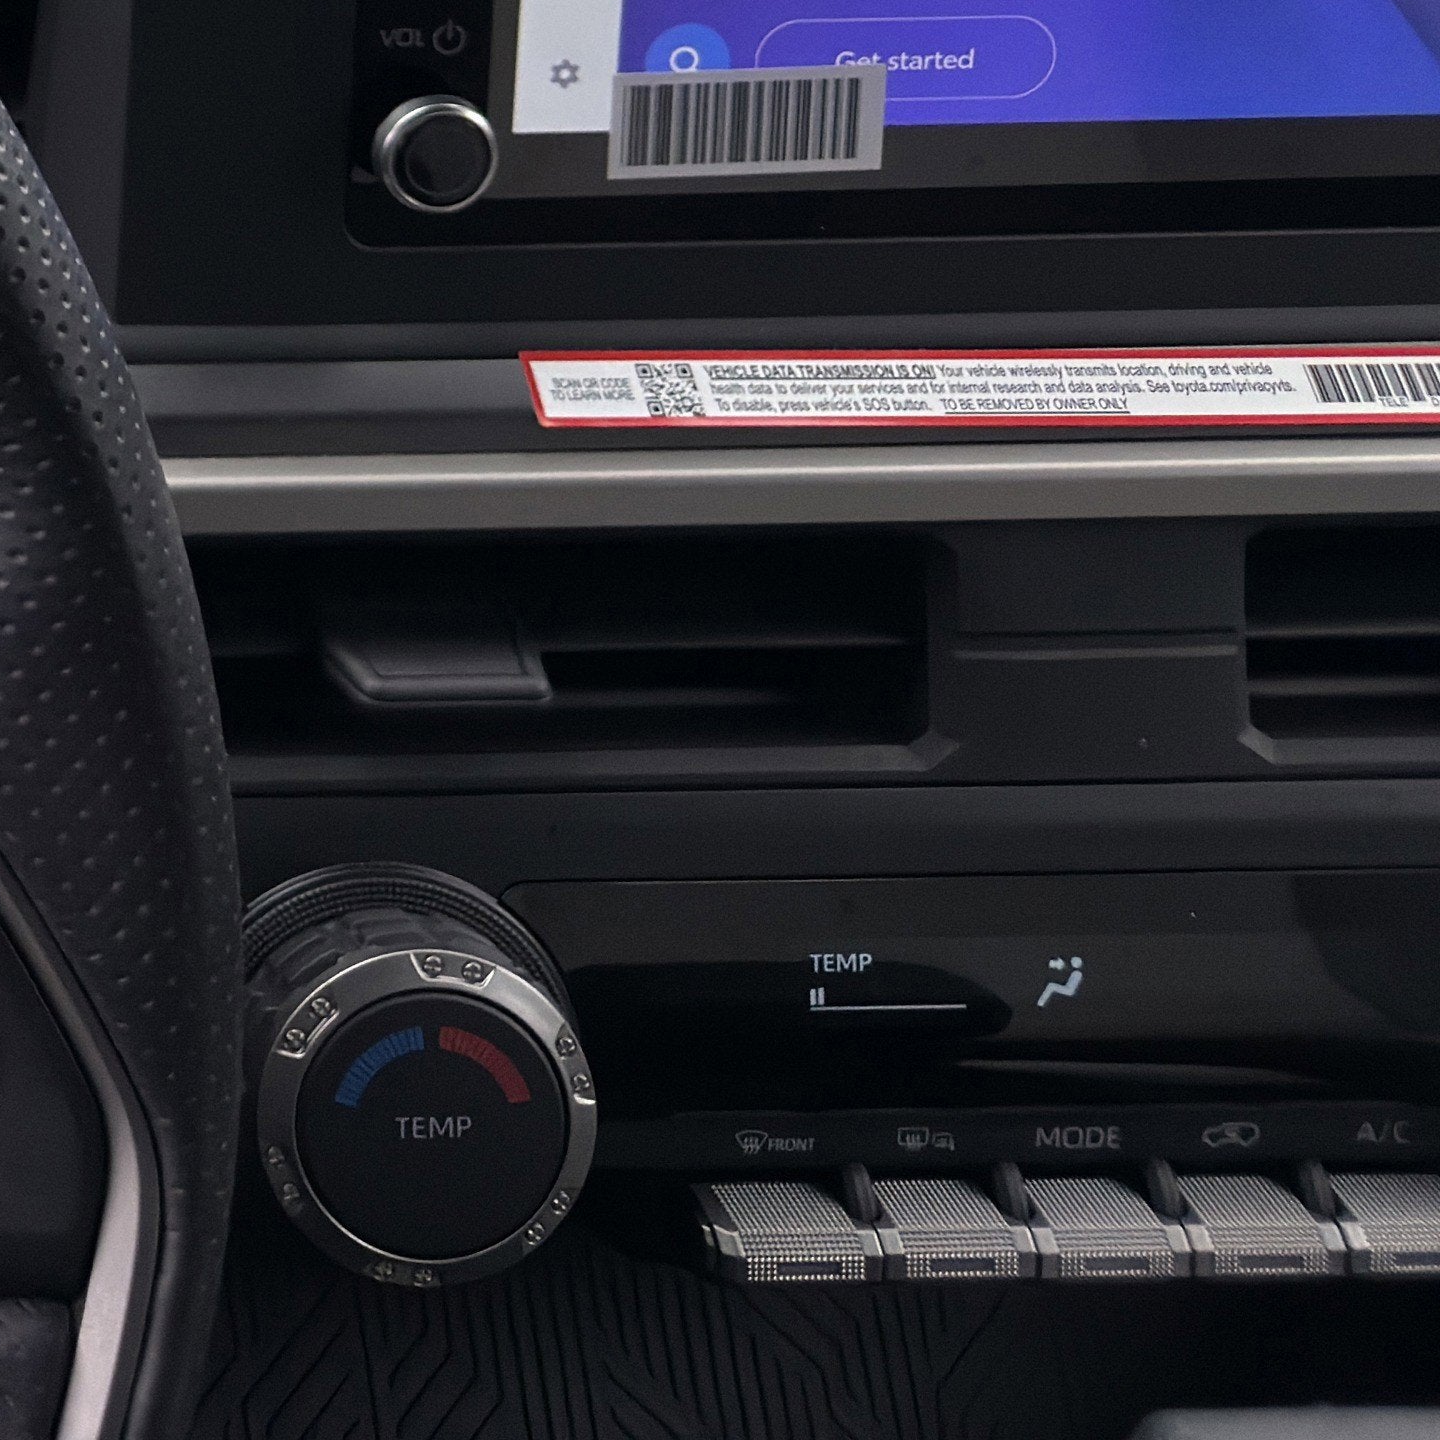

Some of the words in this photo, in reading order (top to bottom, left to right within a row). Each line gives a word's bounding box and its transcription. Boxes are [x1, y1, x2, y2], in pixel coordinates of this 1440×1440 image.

[381, 30, 424, 49] VOL
[887, 49, 975, 72] started
[703, 365, 759, 379] VEHICLE
[762, 365, 795, 379] DATA
[796, 364, 894, 379] TRANSMISSION
[896, 364, 909, 378] IS
[936, 364, 964, 377] Your
[966, 364, 1006, 377] vehicle
[1008, 363, 1062, 379] wirelessly
[1064, 363, 1117, 376] transmits
[1118, 363, 1167, 378] location,
[1168, 362, 1206, 378] driving
[1208, 363, 1231, 376] and
[1232, 362, 1273, 375] vehicle
[748, 382, 772, 395] data
[775, 382, 787, 394] to
[789, 382, 827, 394] deliver
[830, 383, 854, 397] your
[857, 382, 904, 394] services
[907, 381, 927, 394] and
[930, 381, 945, 394] for
[948, 381, 990, 394] internal
[993, 381, 1041, 393] research
[1044, 381, 1065, 393] and
[1068, 381, 1093, 393] data
[1096, 380, 1145, 395] analysis.
[1147, 380, 1169, 392] See
[940, 398, 957, 411] TO
[959, 398, 975, 410] BE
[977, 398, 1036, 410] REMOVED
[1037, 398, 1050, 410] BY
[1053, 398, 1095, 410] OWNER
[1099, 397, 1127, 409] ONLY
[810, 953, 873, 973] TEMP
[395, 1117, 473, 1140] TEMP
[1035, 1126, 1122, 1149] MODE
[1357, 1121, 1410, 1145] A/C
[768, 1135, 815, 1152] FRONT
